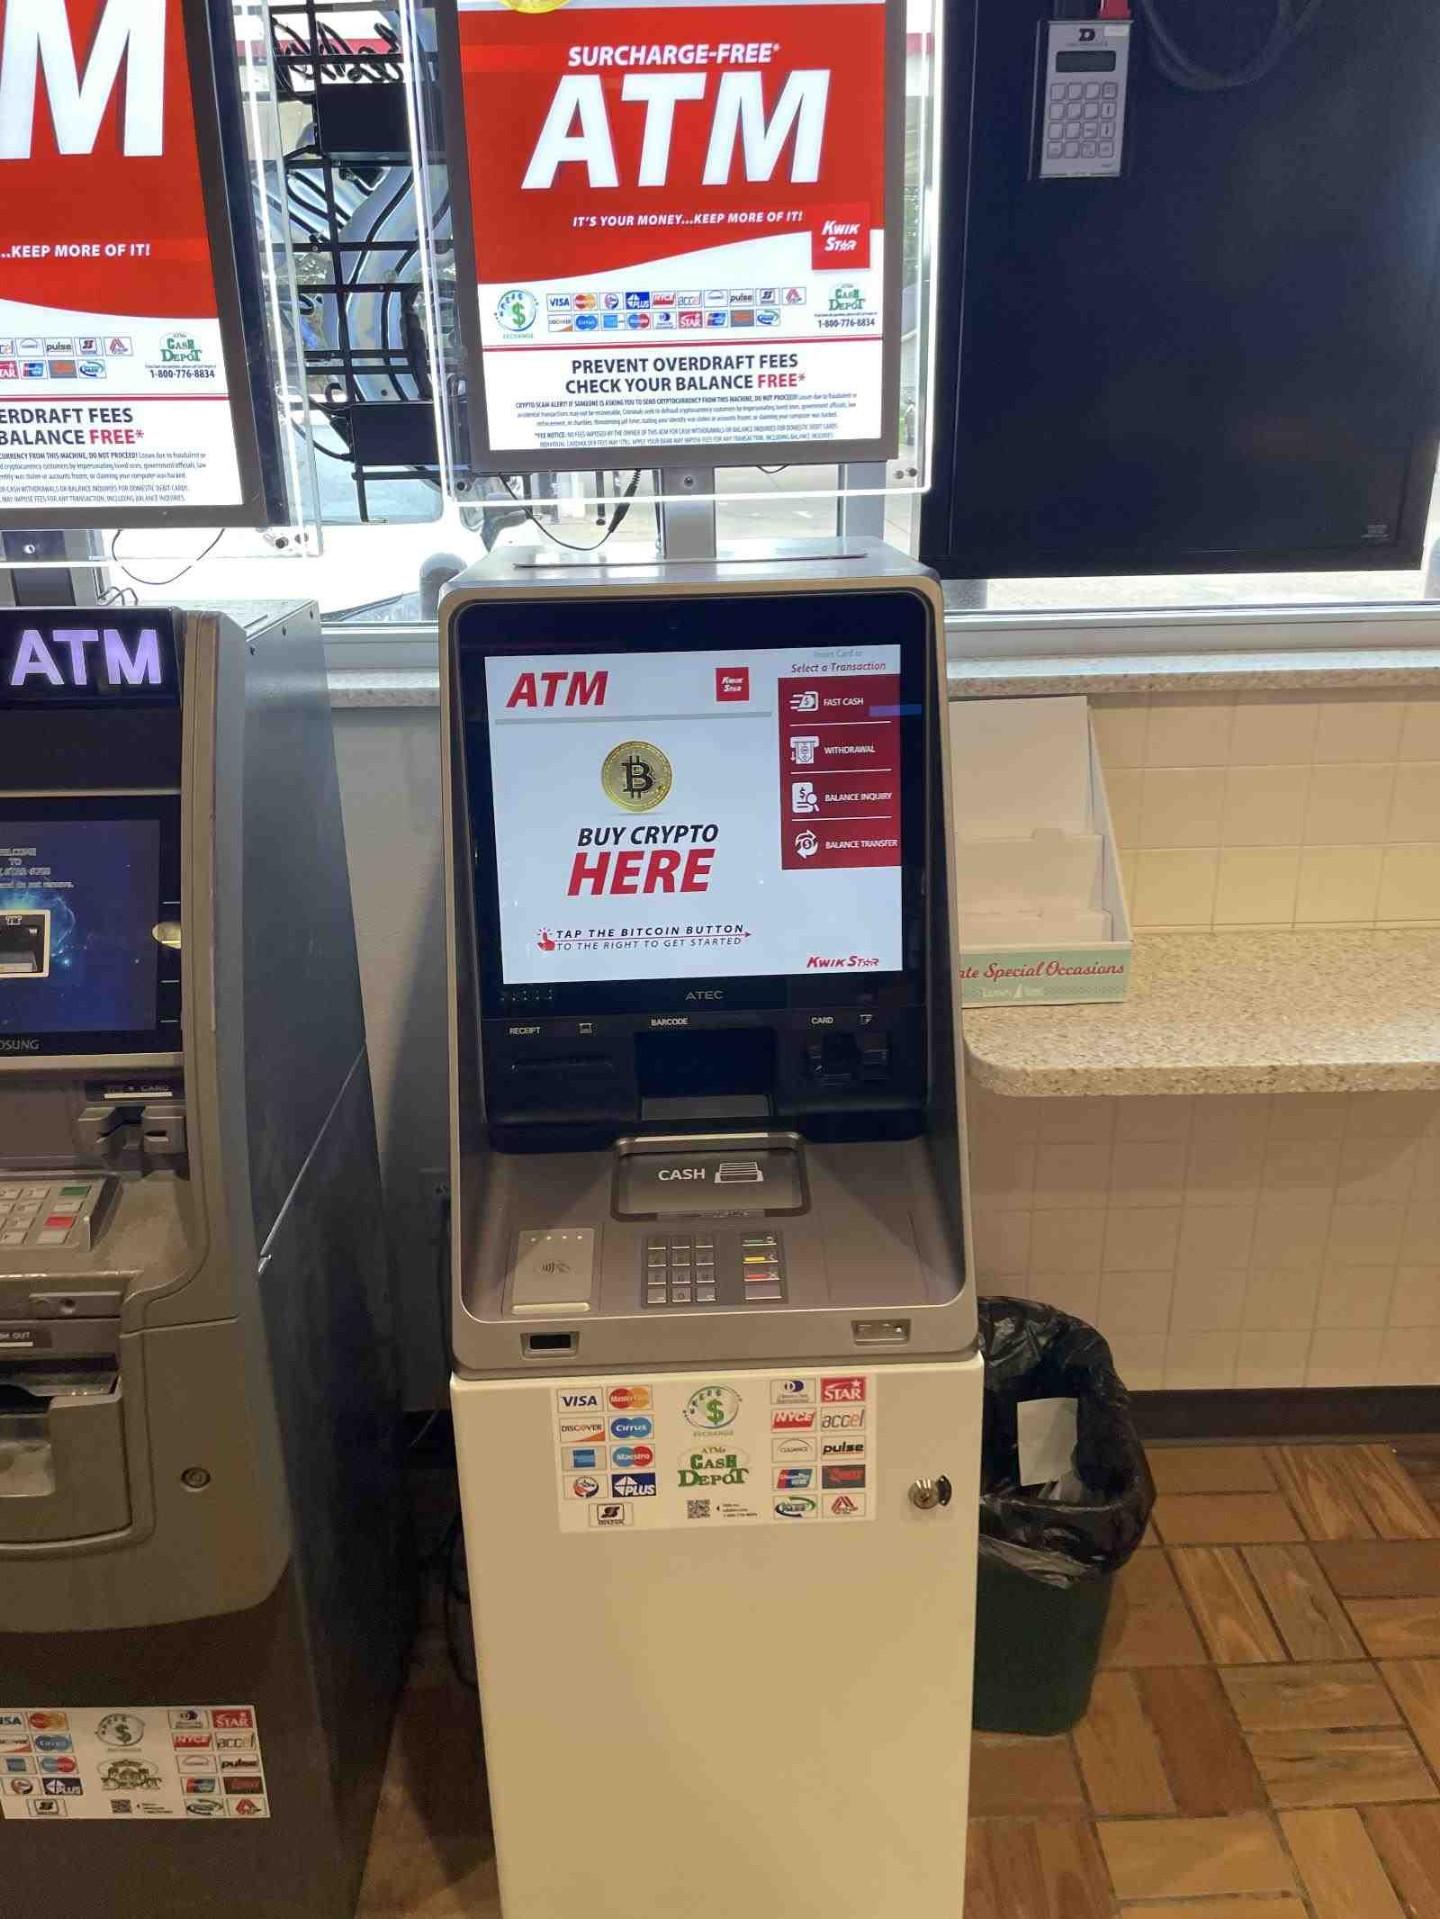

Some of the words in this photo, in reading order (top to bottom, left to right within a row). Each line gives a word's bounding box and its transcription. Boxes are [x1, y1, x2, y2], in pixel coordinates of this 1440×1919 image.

[520, 69, 831, 189] ATM
[573, 216, 597, 227] IT'S
[600, 215, 634, 227] YOUR
[728, 212, 763, 223] MORE
[767, 212, 783, 222] OF
[787, 211, 803, 222] IT!
[54, 244, 101, 257] MORE
[105, 243, 126, 256] OF
[130, 243, 151, 257] IT!
[550, 298, 570, 307] VISA
[829, 299, 866, 311] DEPOT
[46, 342, 72, 352] pulse
[160, 349, 203, 362] DEPOT
[572, 358, 649, 374] PREVENT
[653, 355, 755, 373] OVERDRAFT
[759, 353, 798, 369] FEES
[150, 368, 215, 379] 1-800-776-8834
[565, 379, 621, 394] CHECK
[625, 377, 671, 393] YOUR
[676, 374, 753, 391] BALANCE
[0, 408, 83, 424] ERDRAFT
[90, 407, 134, 423] FEES
[10, 628, 162, 686] ATM
[791, 663, 819, 673] Select
[831, 662, 886, 672] Transaction
[506, 670, 609, 708] ATM
[824, 698, 841, 706] FAST
[843, 697, 864, 706] CASH
[824, 745, 876, 754] WITHDRAWAL
[825, 793, 859, 802] BALANCE
[861, 792, 892, 800] INQUIRY
[577, 826, 626, 847] BUY
[630, 824, 719, 845] CRYPTO
[825, 840, 859, 849] BALANCE
[861, 838, 898, 848] TRANSFER
[567, 848, 716, 896] HERE
[557, 930, 582, 939] TAP
[588, 928, 614, 938] THE
[621, 926, 680, 937] BITCOIN
[686, 924, 744, 935] BUTTON
[557, 942, 572, 951] TO
[577, 941, 600, 950] THE
[602, 940, 638, 950] RIGHT
[644, 940, 659, 949] TO
[664, 939, 685, 948] GET
[690, 937, 742, 947] STARTED
[983, 961, 1045, 982] Special
[1046, 960, 1125, 977] Occasions
[685, 990, 724, 1001] ATEC
[651, 1017, 689, 1026] BARCODE
[811, 1016, 834, 1025] CARD
[509, 1026, 541, 1035] RECEIPT
[657, 1168, 706, 1181] CASH
[561, 1395, 598, 1407] VISA
[823, 1388, 862, 1401] STAR
[774, 1411, 813, 1422] NYCE
[821, 1409, 865, 1429] accel
[822, 1441, 864, 1456] pulse
[690, 1454, 738, 1470] CASH
[677, 1468, 750, 1488] DEPOT
[626, 1484, 656, 1496] PLUS
[216, 1718, 250, 1728] STAR
